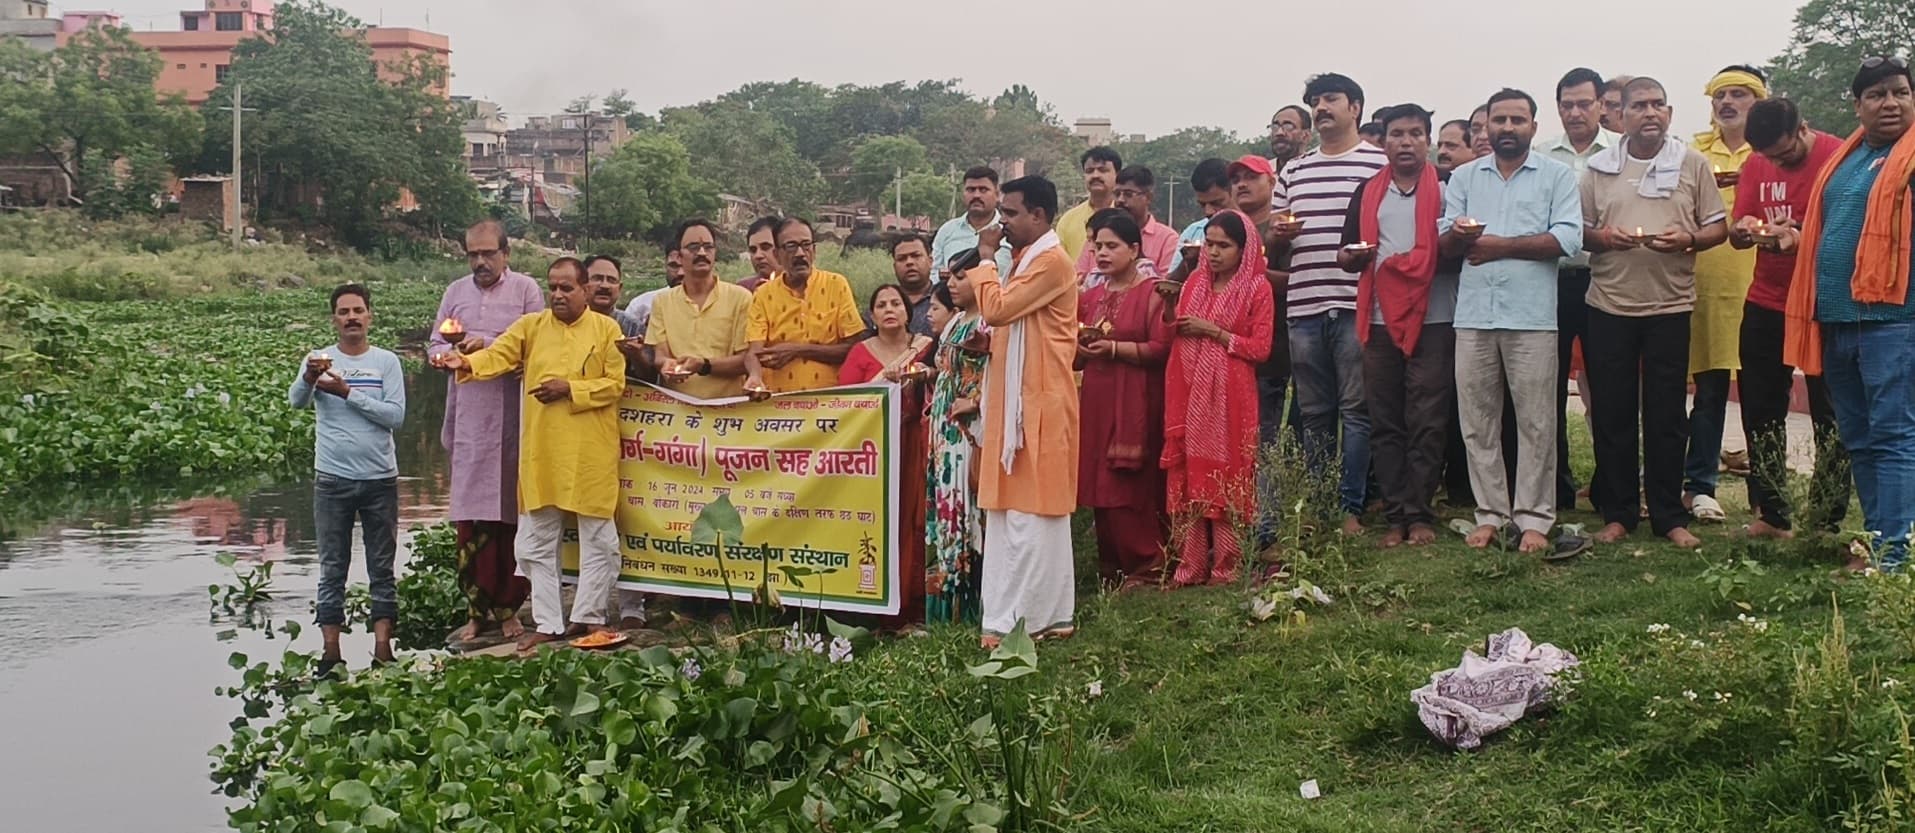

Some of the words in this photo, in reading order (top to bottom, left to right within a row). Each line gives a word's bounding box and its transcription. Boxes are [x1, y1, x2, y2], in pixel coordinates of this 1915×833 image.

[1760, 181, 1787, 202] I'M
[619, 407, 674, 426] दशहरा
[685, 410, 703, 429] के
[713, 417, 744, 436] शुभ
[754, 419, 805, 433] अवसर
[816, 419, 839, 433] पर
[715, 447, 769, 481] पूजन
[775, 449, 812, 476] सह
[815, 440, 878, 476] आरती
[648, 481, 658, 491] 16
[664, 483, 678, 496] जून
[682, 485, 704, 495] 2024
[625, 532, 650, 550] एवं
[651, 535, 720, 559] पर्यावरण
[724, 541, 784, 562] संरक्षण
[789, 543, 850, 568] संस्थान
[694, 567, 756, 582] 134911-12
